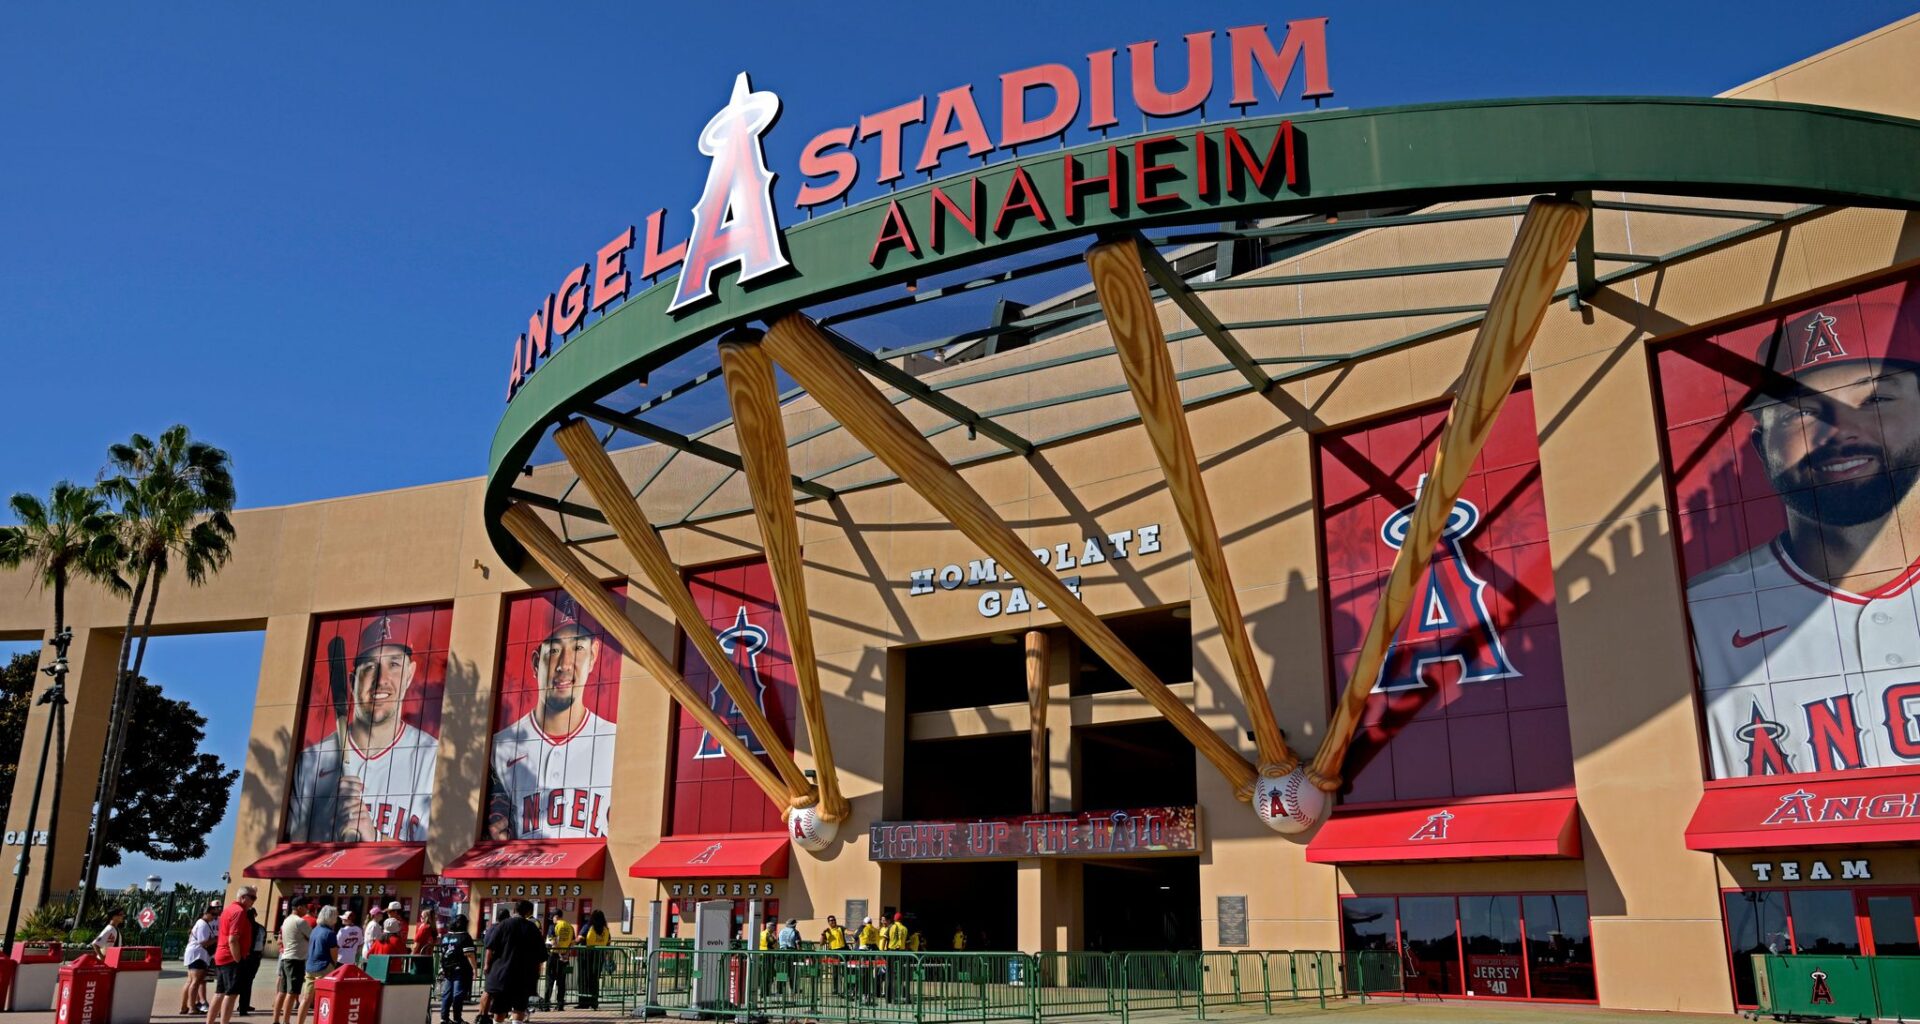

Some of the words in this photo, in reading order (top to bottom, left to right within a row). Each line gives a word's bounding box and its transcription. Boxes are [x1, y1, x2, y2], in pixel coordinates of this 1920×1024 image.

[796, 17, 1334, 209] STADIUM
[870, 120, 1306, 265] ANAHEIM
[1802, 312, 1847, 366] A
[910, 524, 1160, 596] HOMLATE
[978, 576, 1081, 617] GAE
[521, 788, 611, 837] NGEL
[1268, 786, 1289, 817] A
[794, 815, 806, 839] A
[966, 821, 1009, 855] UP
[1023, 819, 1078, 852] THE
[1089, 810, 1168, 851] HALO
[1409, 810, 1455, 840] A
[687, 843, 722, 865] A
[1752, 860, 1872, 881] TEAM
[304, 884, 386, 895] TICKETS
[491, 885, 582, 896] TICKETS
[673, 884, 774, 896] TICKETS
[143, 911, 151, 923] 2
[342, 937, 359, 949] 27
[1473, 966, 1519, 979] JERSEY
[1811, 967, 1835, 1004] A
[1487, 980, 1508, 994] $40
